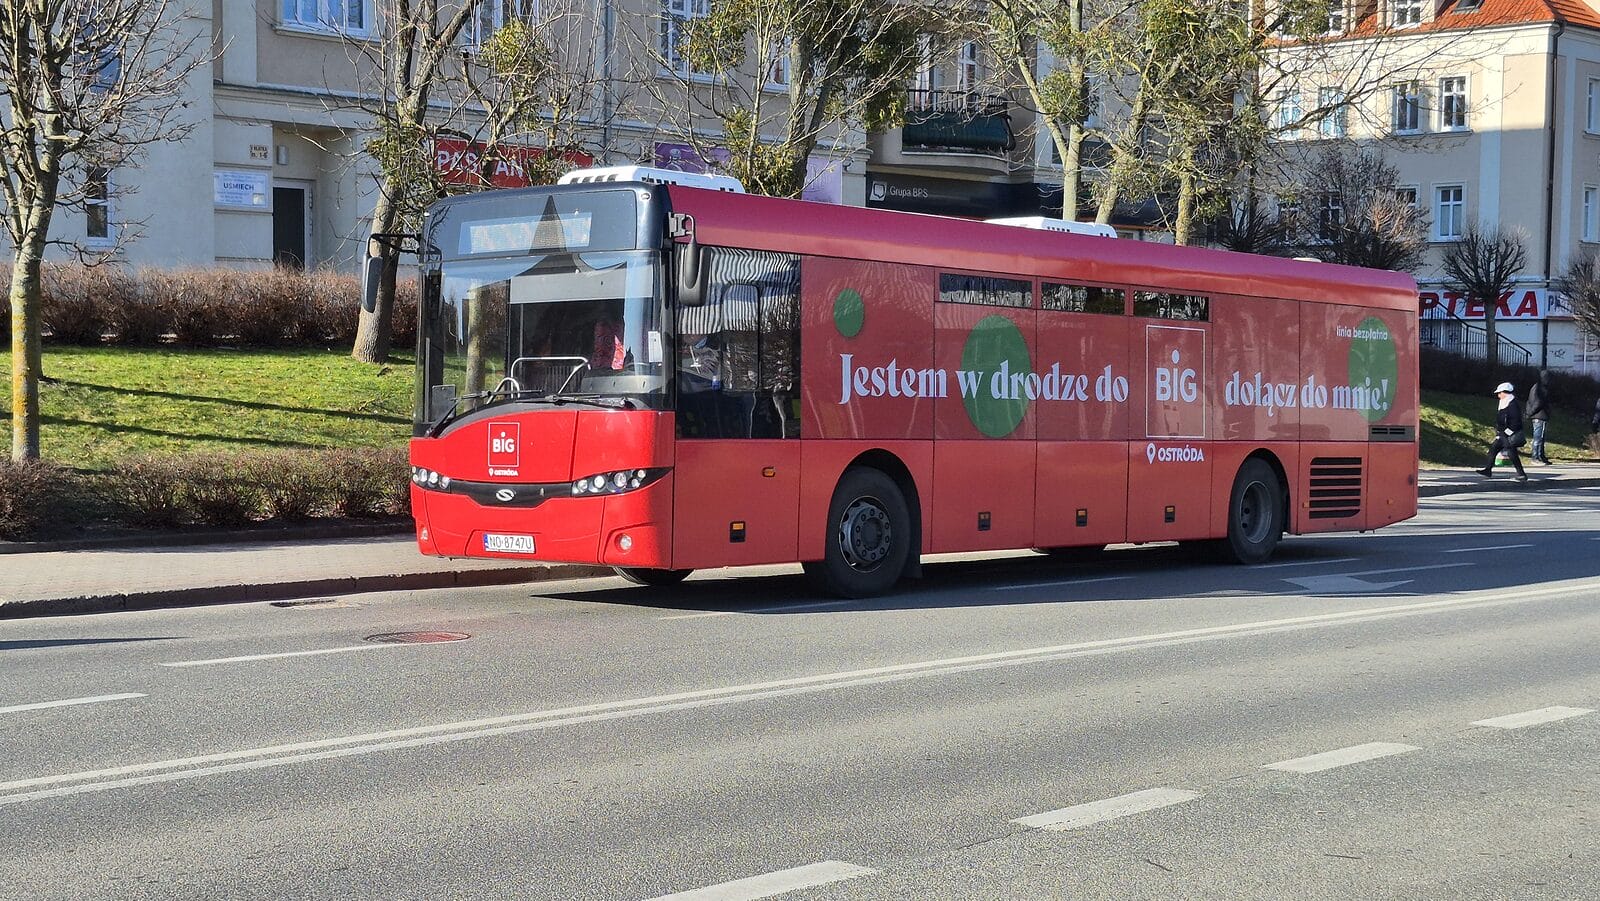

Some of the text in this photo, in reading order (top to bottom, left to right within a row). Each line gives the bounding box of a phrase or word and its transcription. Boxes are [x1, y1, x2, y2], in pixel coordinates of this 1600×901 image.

[890, 186, 929, 199] Grupa BPS
[1419, 291, 1539, 318] PTEKA
[1336, 325, 1388, 342] linia bezpłatna
[838, 353, 1129, 405] Jestem w drodze do
[1225, 370, 1389, 417] dołącz do mnie!
[1157, 444, 1204, 463] OSTRÓDA
